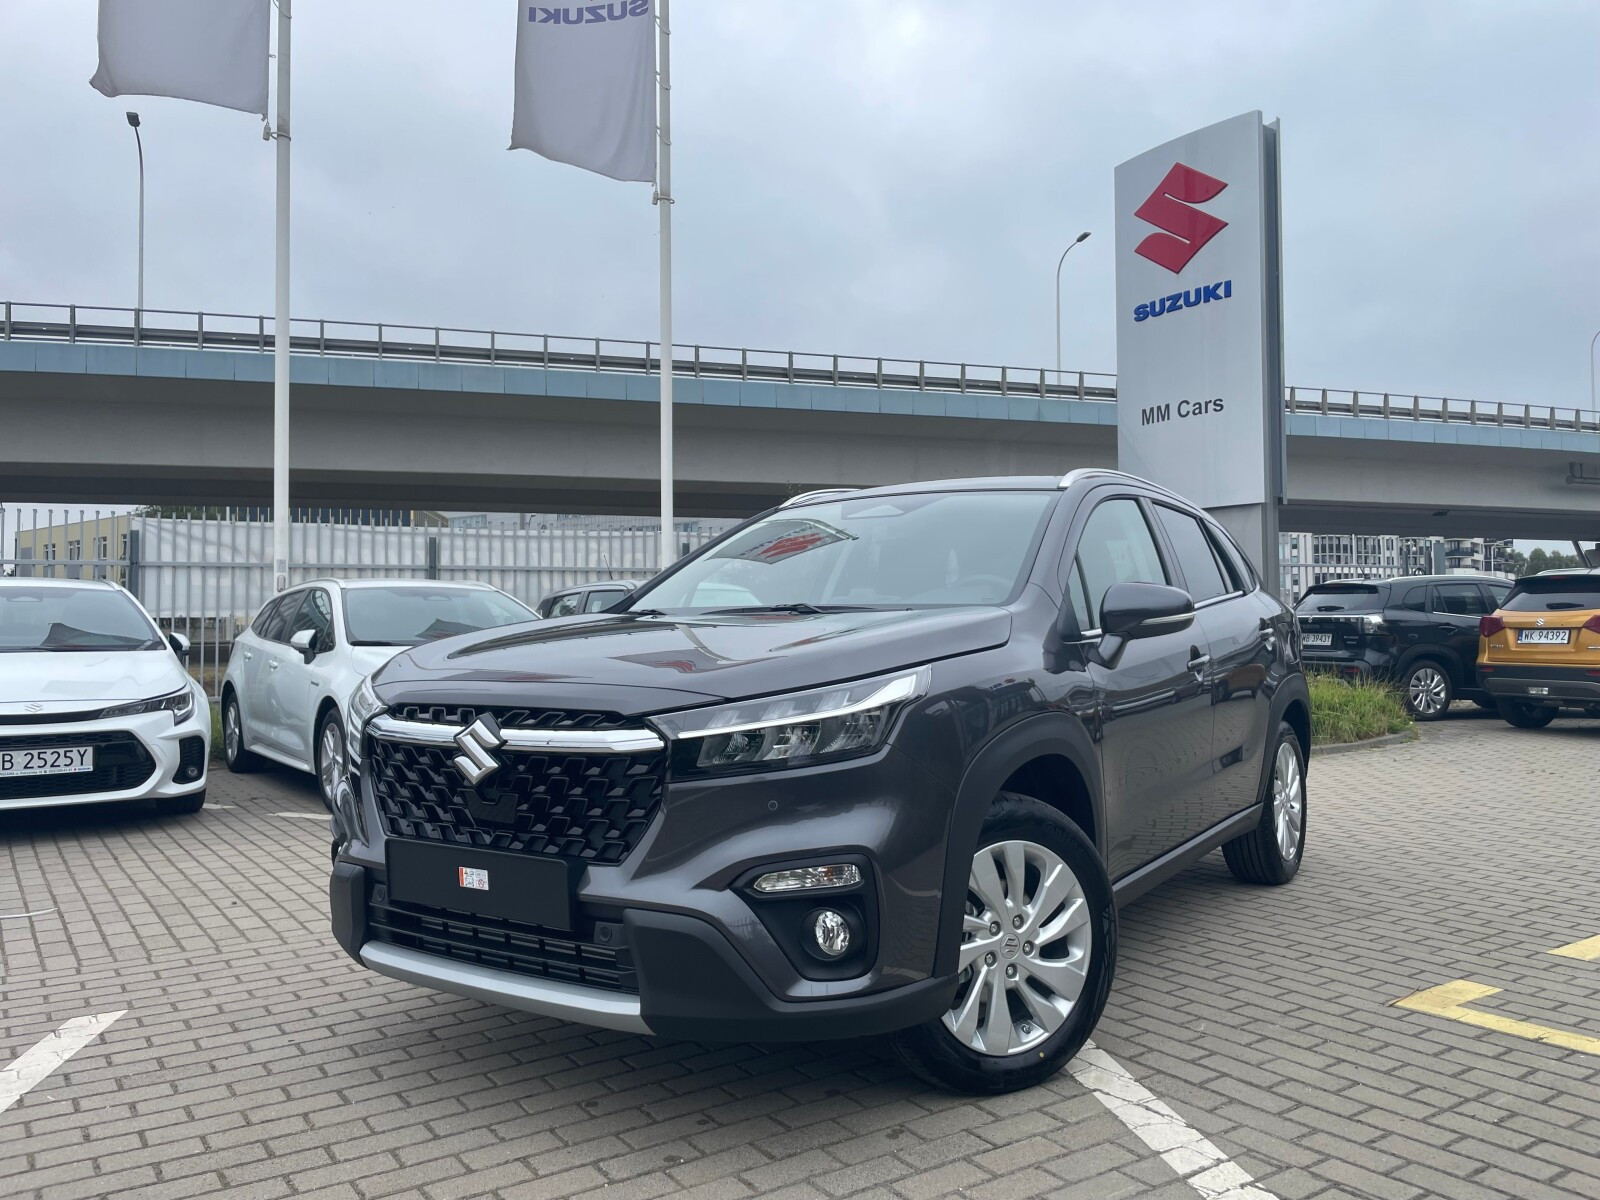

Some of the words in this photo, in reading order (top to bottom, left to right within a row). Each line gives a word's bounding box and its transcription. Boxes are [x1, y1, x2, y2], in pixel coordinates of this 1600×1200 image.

[1133, 279, 1232, 322] SUZUKI
[1141, 403, 1170, 426] MM
[1177, 398, 1224, 418] Cars
[1312, 634, 1330, 642] 3943Y
[1524, 631, 1535, 640] WK
[1538, 631, 1567, 640] 94392
[23, 749, 88, 769] 2525Y
